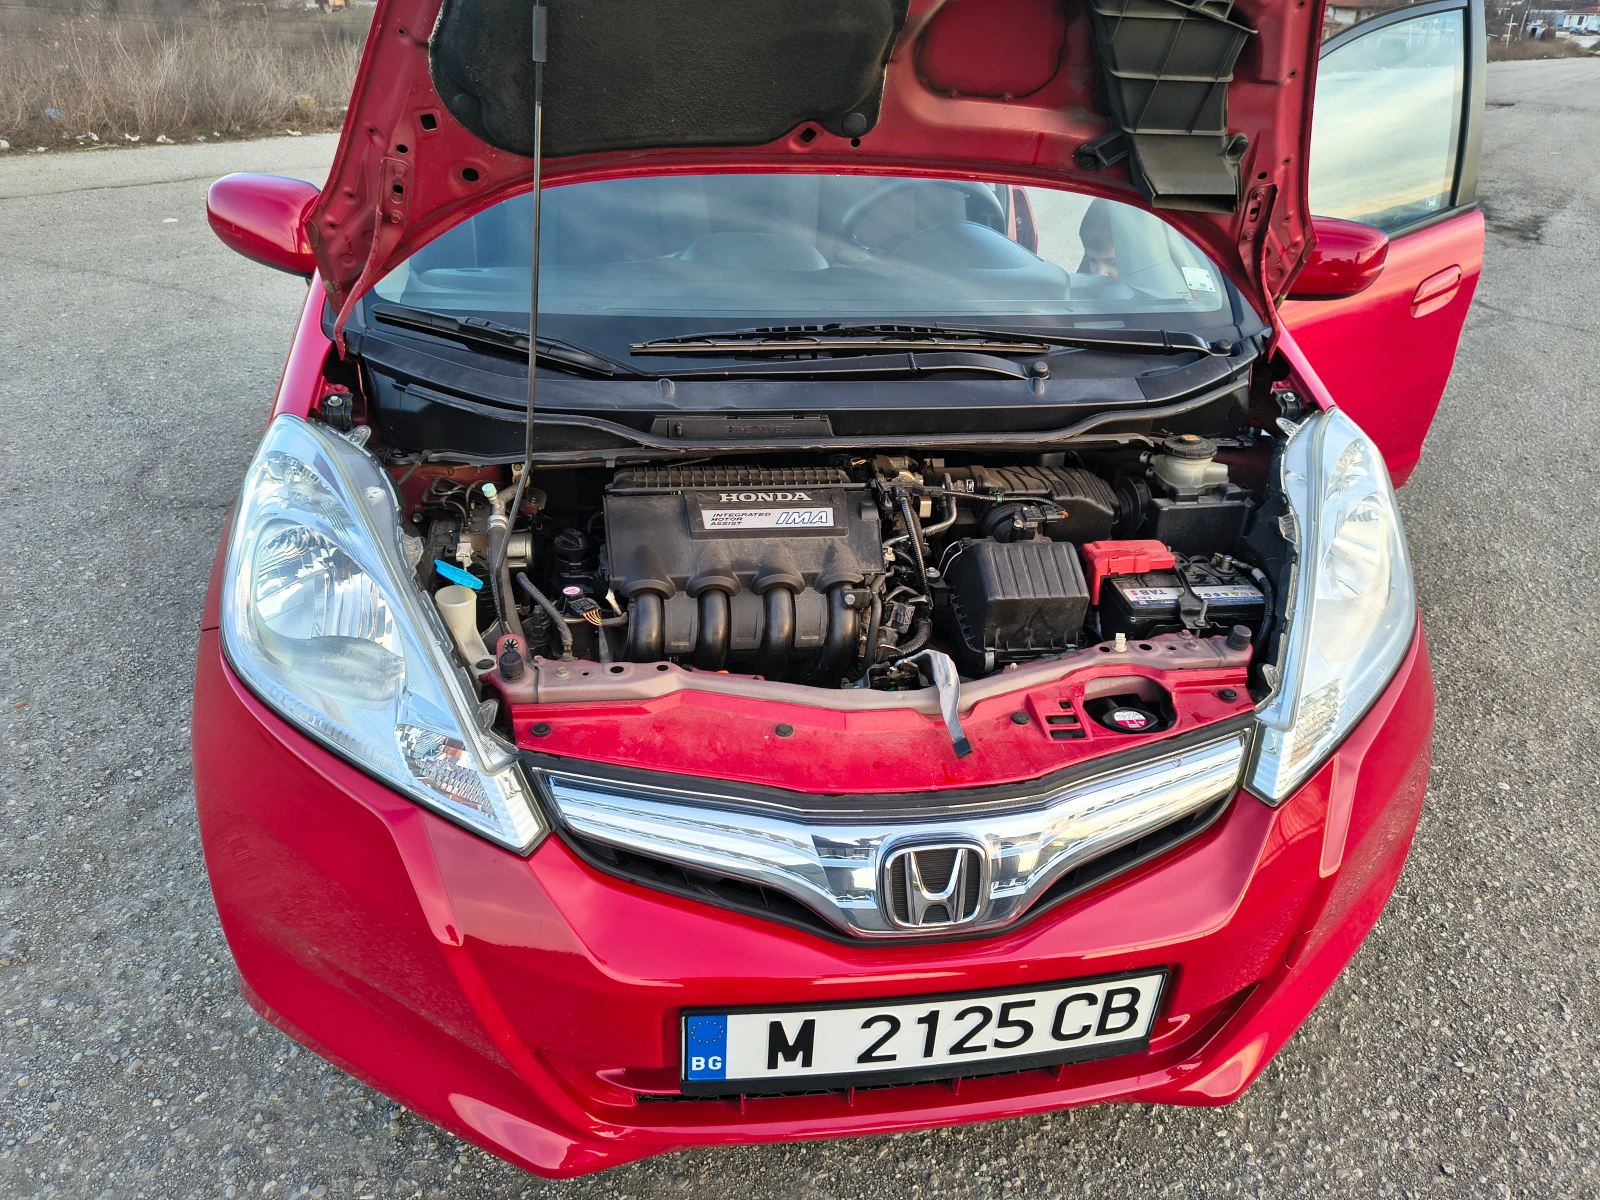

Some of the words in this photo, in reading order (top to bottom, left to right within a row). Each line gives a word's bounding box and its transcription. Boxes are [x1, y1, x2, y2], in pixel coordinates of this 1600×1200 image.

[757, 424, 793, 434] NUMBER
[718, 492, 812, 502] HONDA
[775, 511, 828, 525] IMA
[767, 1018, 816, 1070] M
[856, 1000, 1036, 1064] 2125
[1051, 986, 1141, 1041] CB
[691, 1055, 723, 1071] BG
